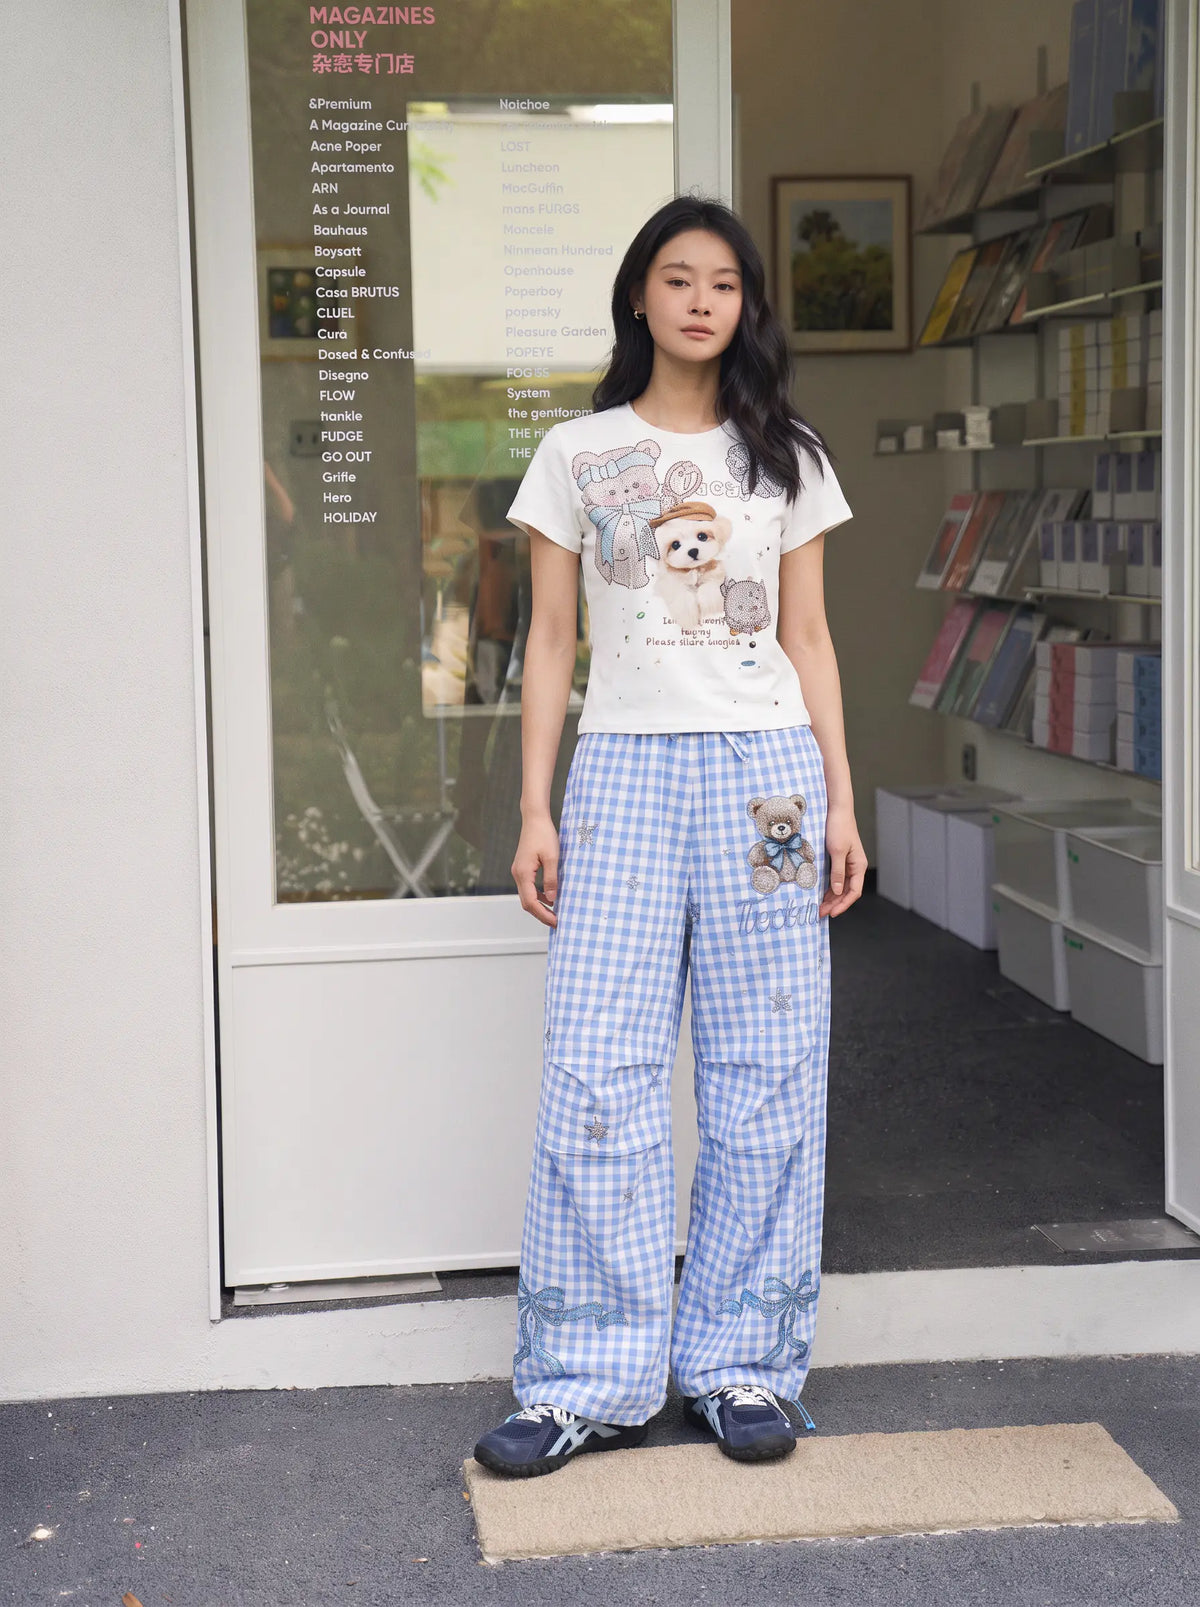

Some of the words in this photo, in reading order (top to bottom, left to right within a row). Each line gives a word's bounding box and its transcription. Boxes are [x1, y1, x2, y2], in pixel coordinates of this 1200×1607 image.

[309, 6, 436, 25] MAGAZINES
[310, 30, 368, 49] ONLY
[308, 98, 372, 110] &Premium
[309, 120, 319, 131] A
[321, 120, 383, 134] Magazine
[310, 141, 342, 152] Acne
[500, 141, 531, 152] LOST
[311, 162, 395, 176] Apartamento
[501, 161, 560, 173] Luncheon
[311, 183, 338, 194] ARN
[312, 204, 328, 215] As
[330, 206, 340, 215] a
[343, 204, 390, 215] Journal
[313, 225, 368, 236] Bauhaus
[315, 266, 367, 280] Capsule
[315, 287, 348, 298] Casa
[351, 286, 400, 298] BRUTUS
[316, 308, 356, 319] CLUEL
[560, 325, 607, 337] Garden
[360, 349, 370, 360] &
[372, 347, 431, 361] Confusd
[506, 346, 554, 358] POPEYE
[318, 370, 369, 384] Disegno
[319, 390, 356, 401] FLOW
[507, 388, 551, 401] System
[508, 407, 528, 419] the
[321, 431, 364, 442] FUDGE
[508, 427, 532, 439] THE
[321, 452, 343, 463] GO
[345, 451, 373, 463] OUT
[508, 447, 532, 459] THE
[323, 492, 352, 503] Hero
[323, 512, 378, 523] HOLIDAY
[646, 637, 676, 646] Please
